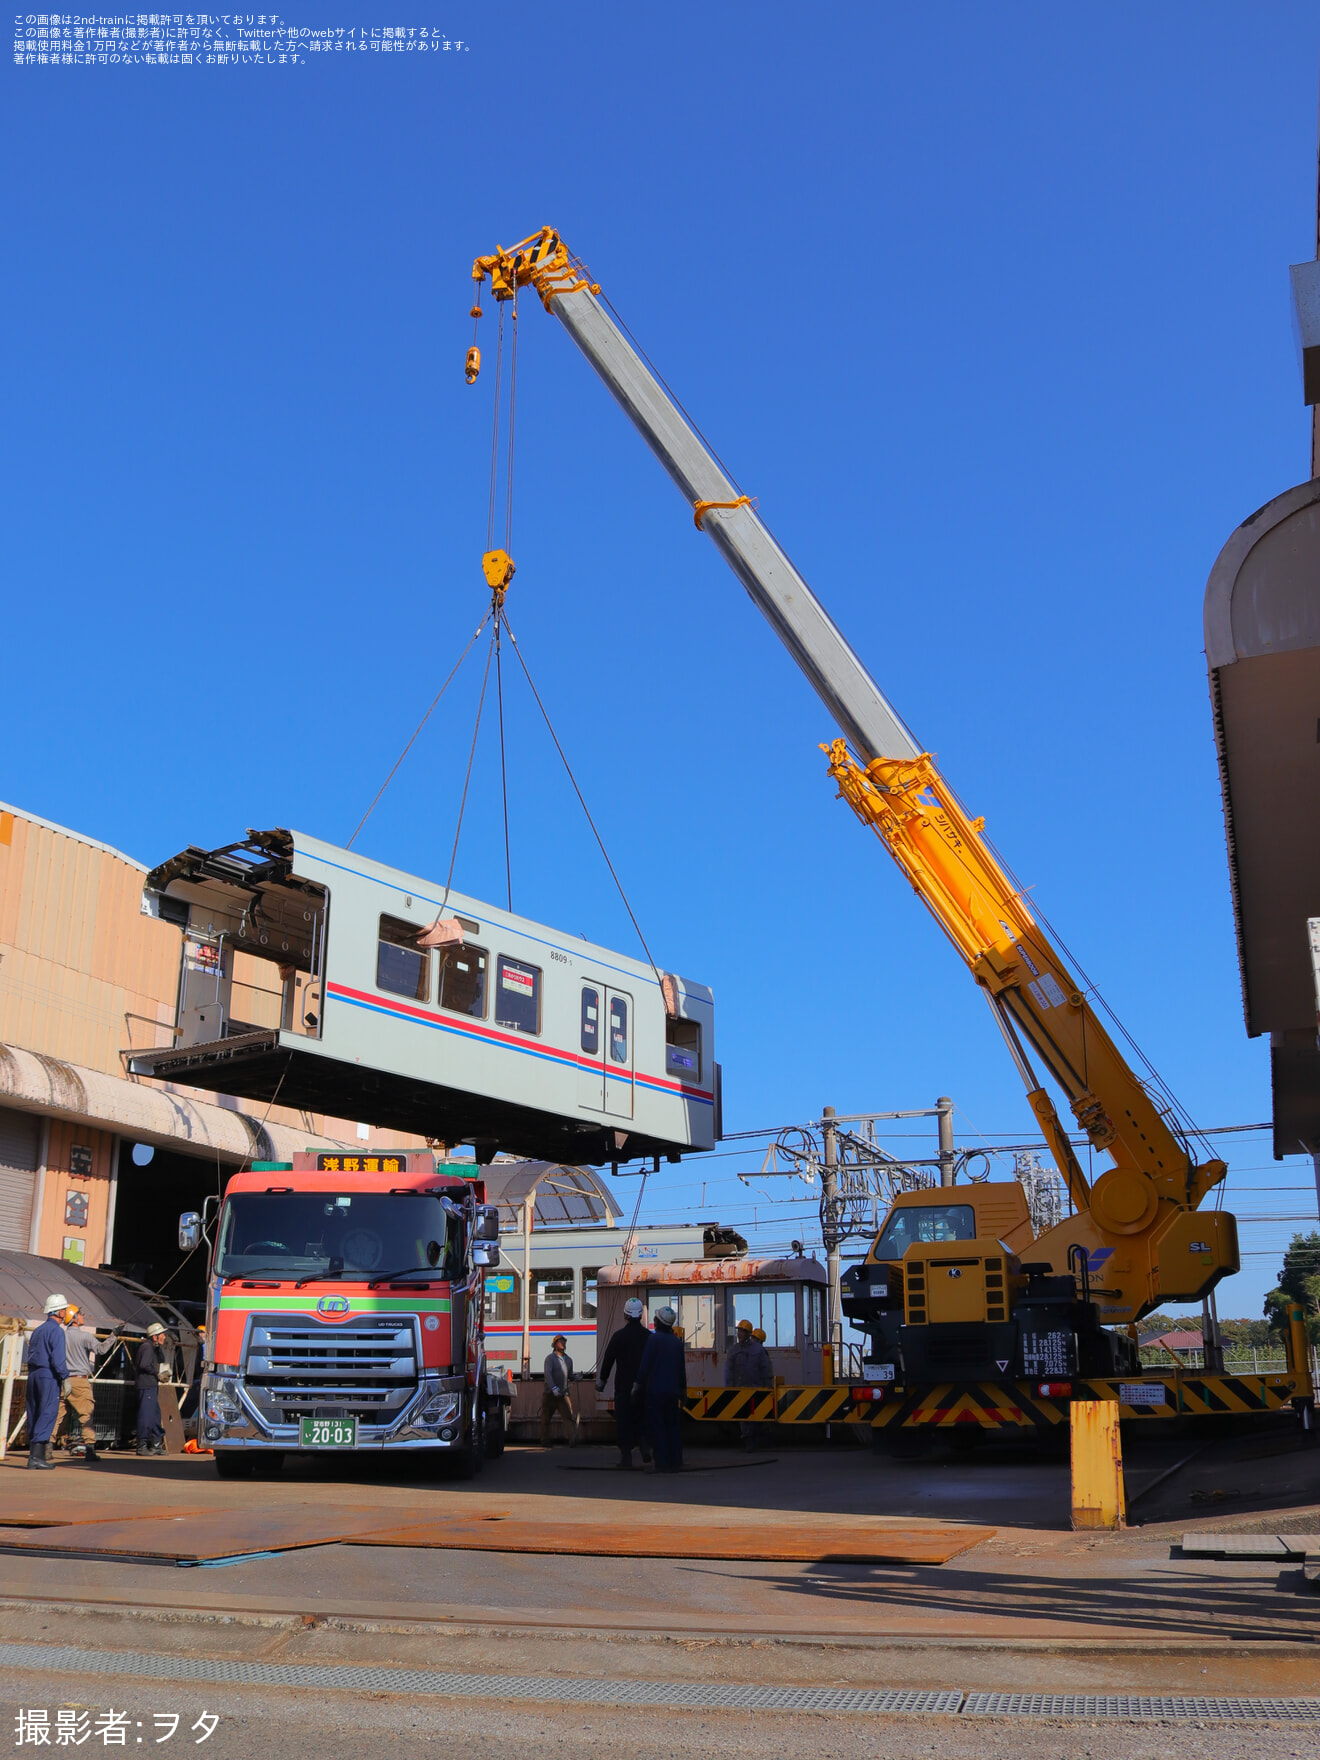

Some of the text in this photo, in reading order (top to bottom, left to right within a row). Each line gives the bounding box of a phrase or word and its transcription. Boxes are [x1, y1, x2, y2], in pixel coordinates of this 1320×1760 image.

[323, 1157, 400, 1173] 浅野運輸
[1189, 1242, 1211, 1252] SL
[320, 1301, 347, 1312] UD
[312, 1427, 353, 1443] 20-03
